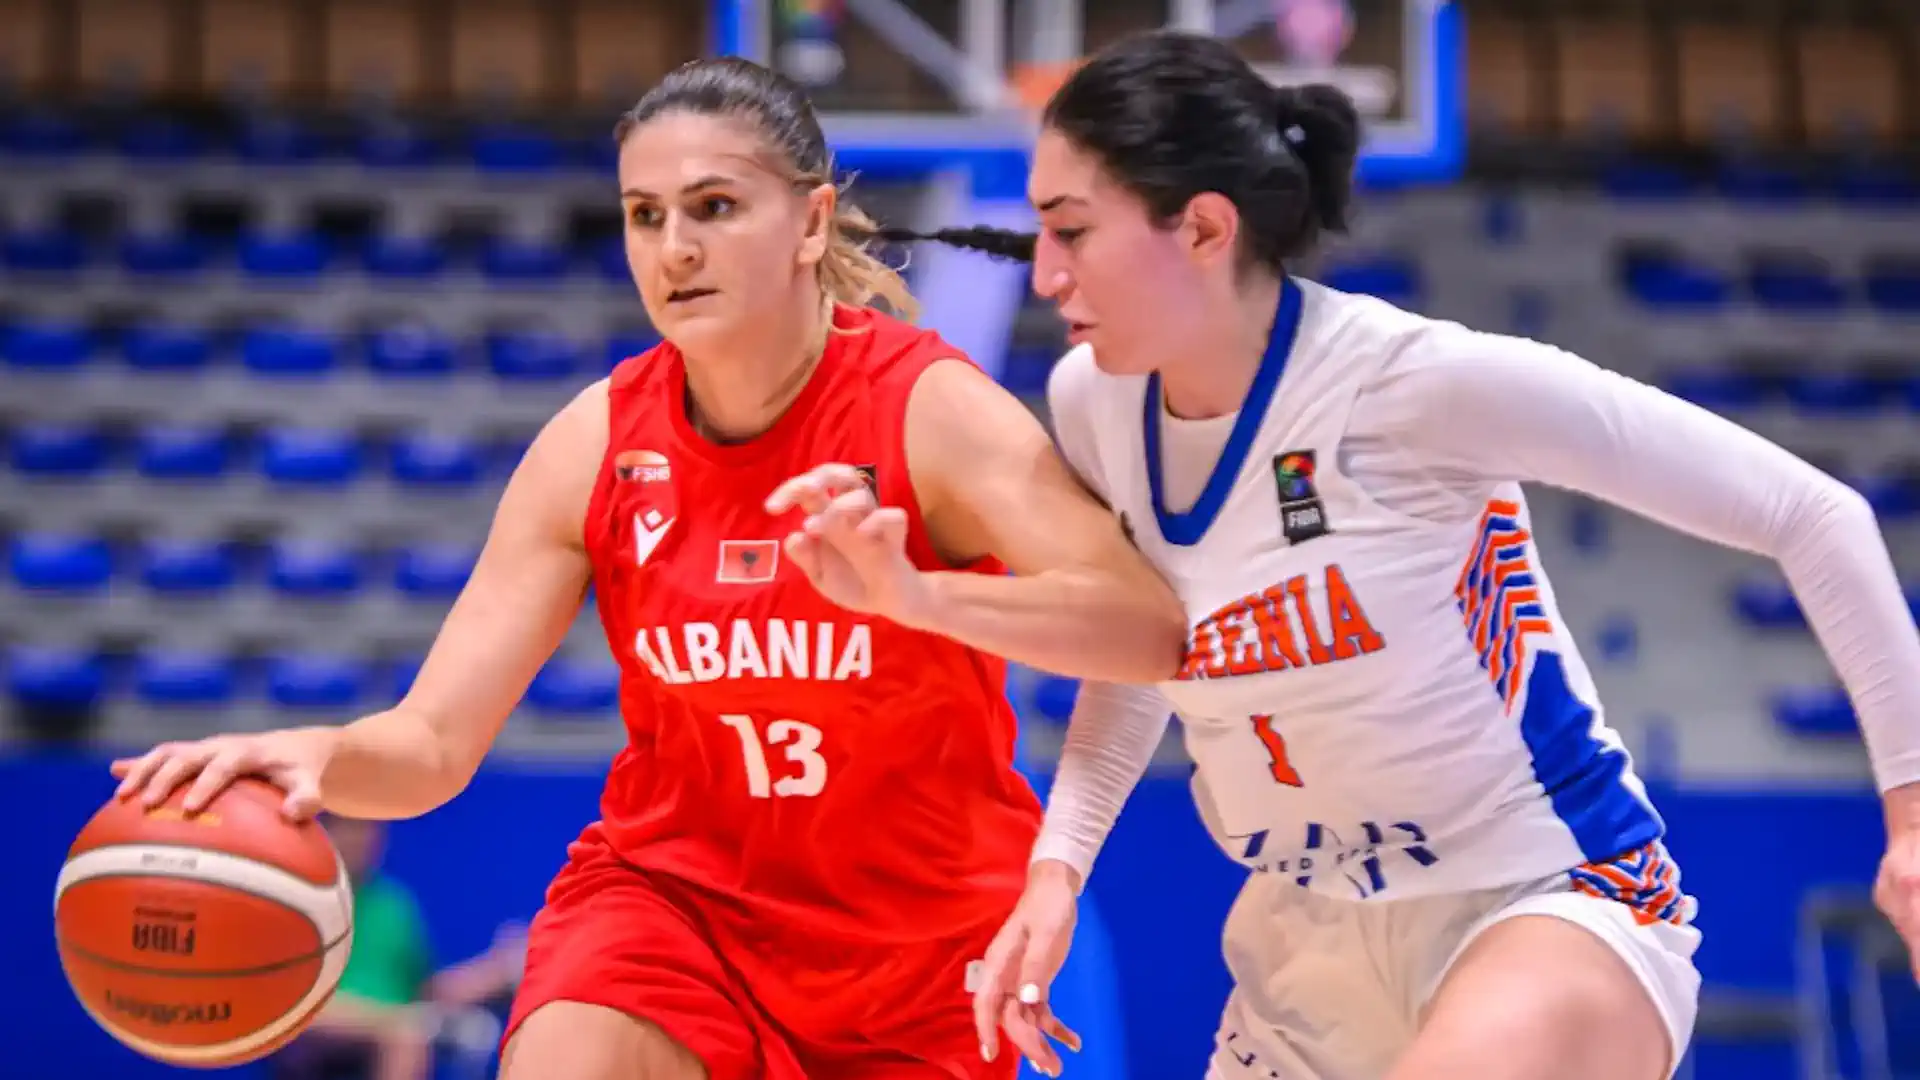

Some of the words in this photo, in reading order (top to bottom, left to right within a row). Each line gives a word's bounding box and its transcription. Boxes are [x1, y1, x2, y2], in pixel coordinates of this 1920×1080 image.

[635, 618, 872, 684] ALBANIA
[1173, 562, 1387, 681] MENIA
[718, 713, 828, 799] 13
[1249, 714, 1304, 788] 1
[132, 924, 196, 956] FIBA
